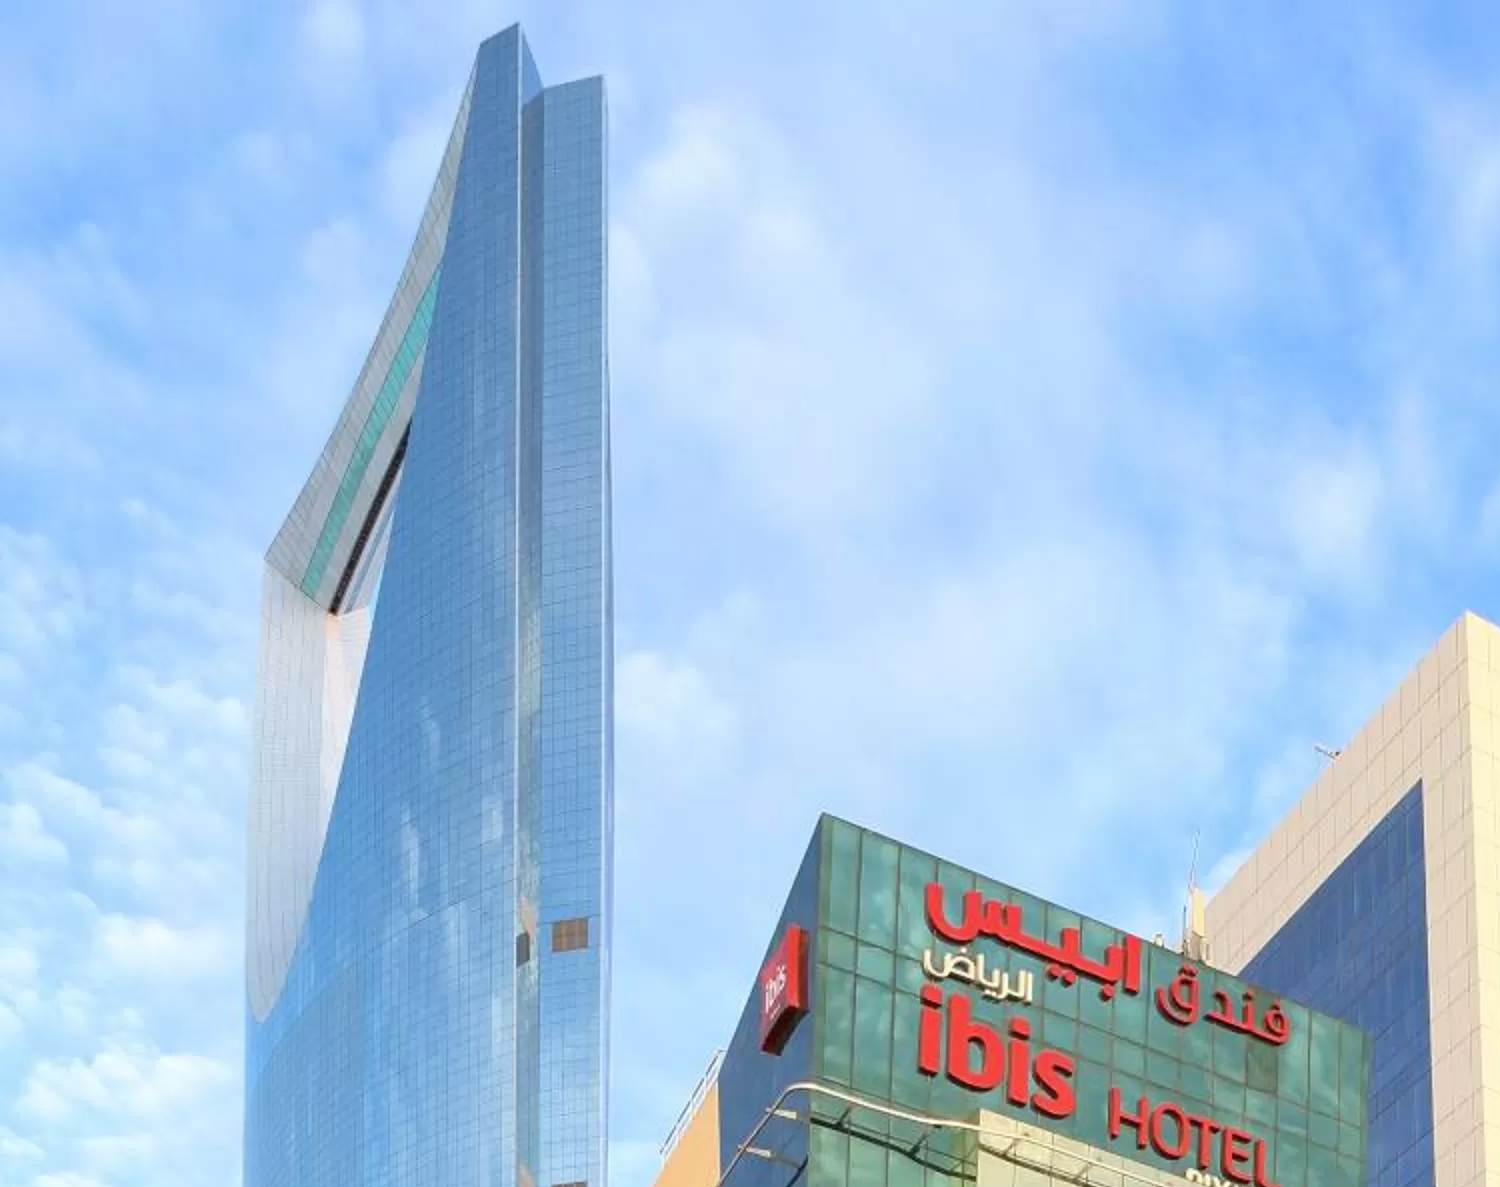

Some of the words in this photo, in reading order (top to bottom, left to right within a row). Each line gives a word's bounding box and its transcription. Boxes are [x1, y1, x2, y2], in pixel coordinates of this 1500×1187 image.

[923, 947, 1033, 1002] الرياض
[924, 882, 1141, 998] ابيس
[764, 963, 788, 1014] ibis
[1157, 965, 1290, 1045] فندق
[918, 982, 1076, 1121] ibis
